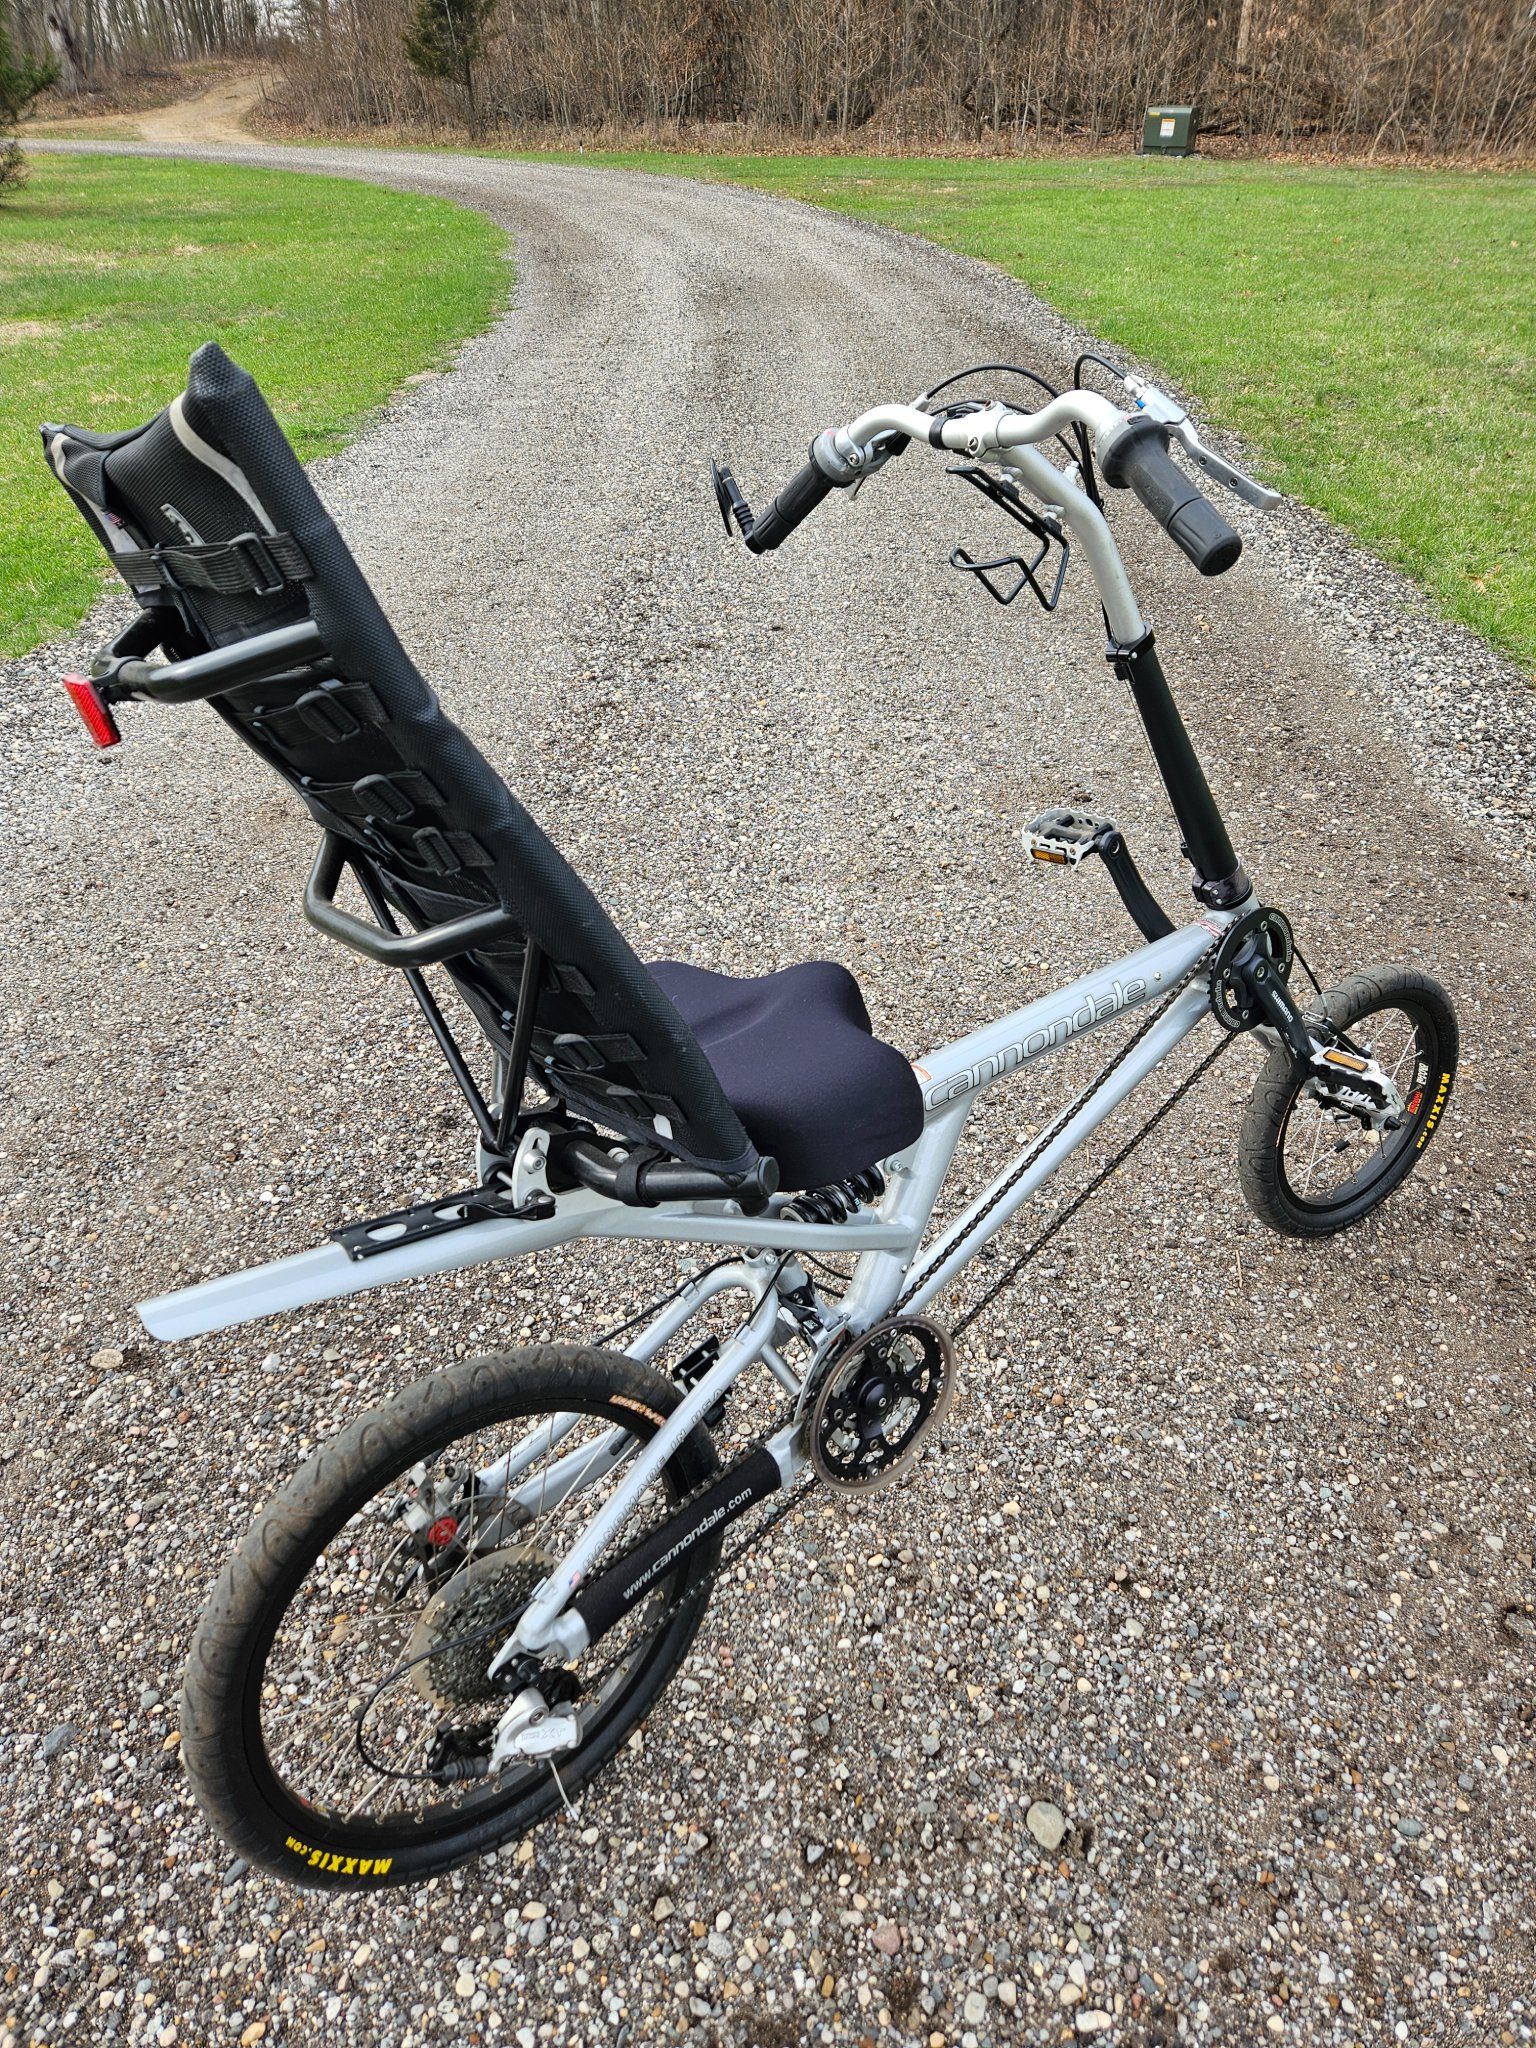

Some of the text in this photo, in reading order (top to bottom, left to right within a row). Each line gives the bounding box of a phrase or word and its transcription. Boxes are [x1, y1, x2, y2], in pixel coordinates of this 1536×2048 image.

[924, 978, 1146, 1112] cannondale
[1271, 989, 1294, 1023] SHIMANO
[583, 1388, 723, 1570] HANDMADE IN USA
[622, 1486, 753, 1600] www.cannondale.com
